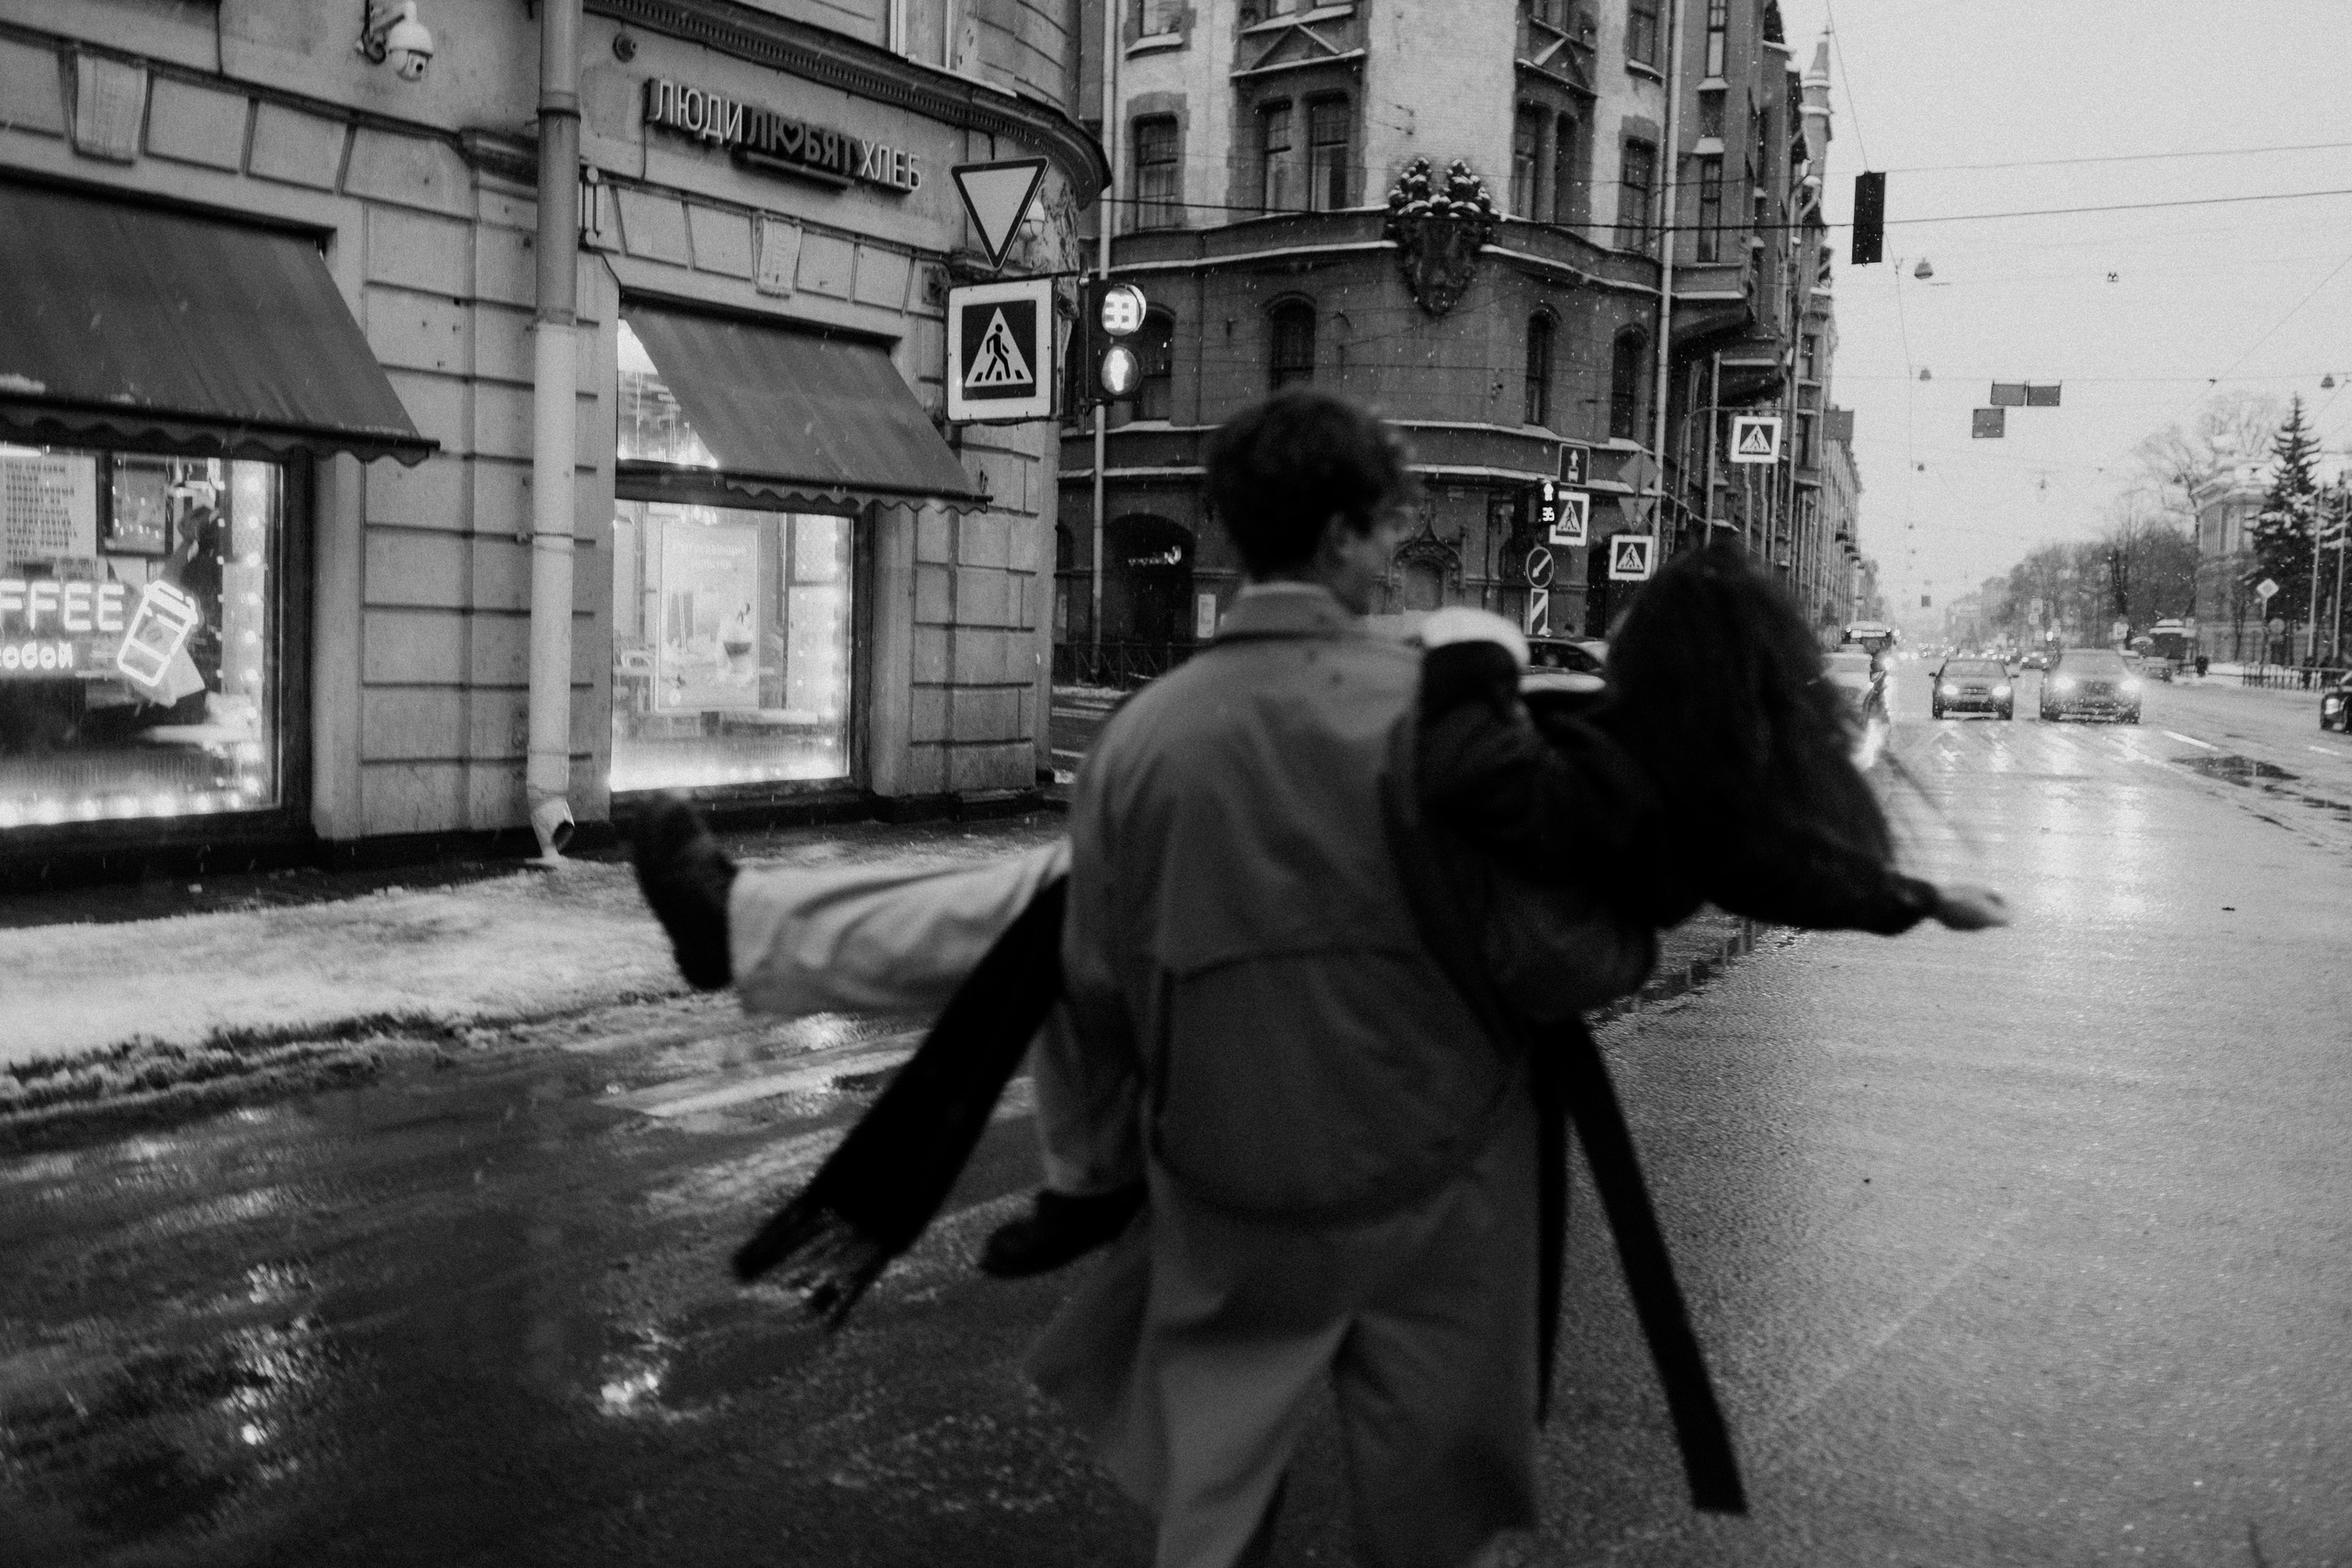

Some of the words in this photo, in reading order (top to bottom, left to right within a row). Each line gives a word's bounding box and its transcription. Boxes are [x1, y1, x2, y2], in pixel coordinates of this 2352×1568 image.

[650, 77, 743, 144] ЛЮДИ
[860, 139, 922, 191] ХЛЕБ
[0, 640, 74, 670] обой
